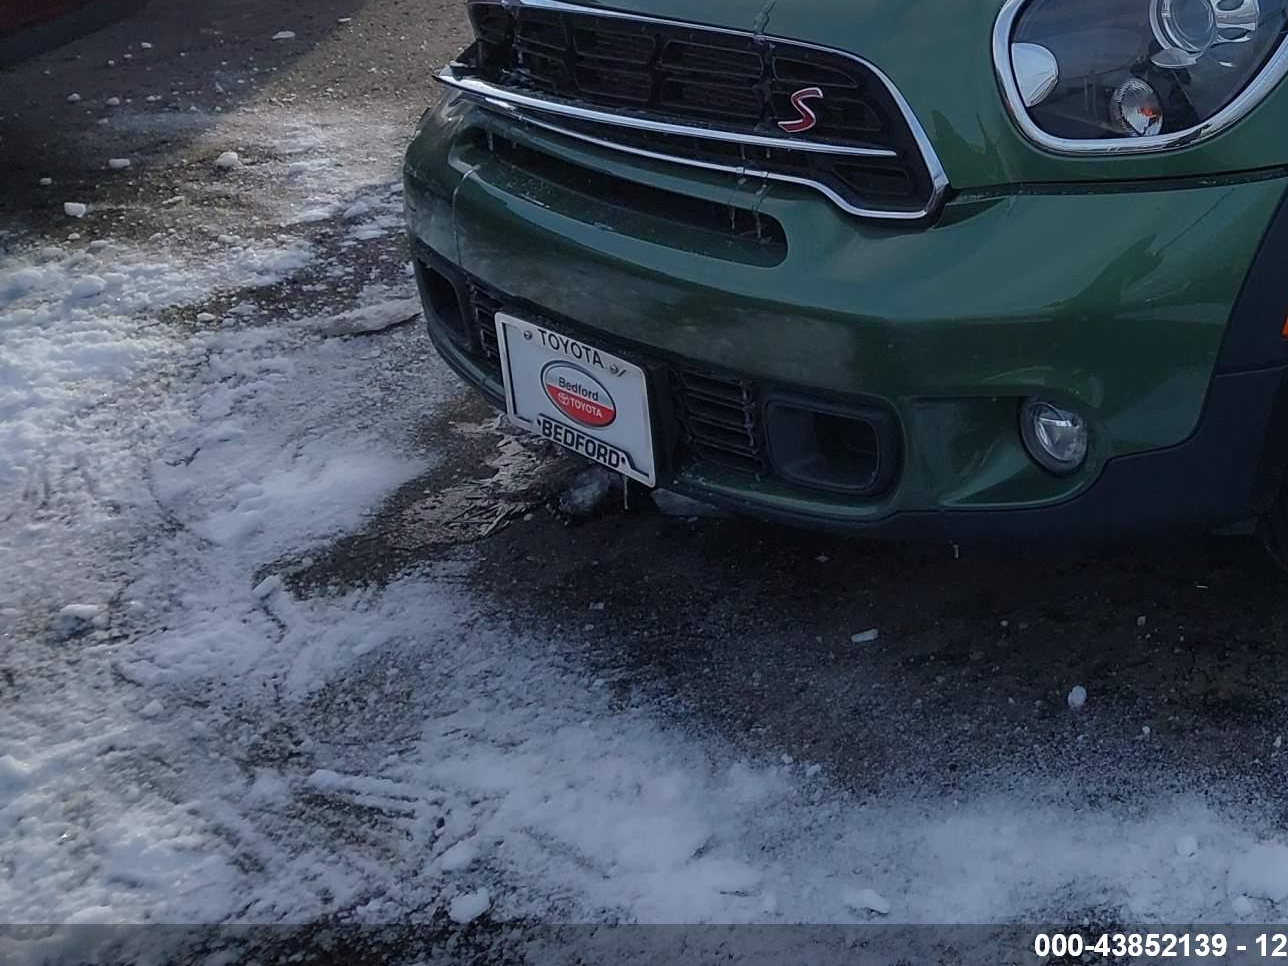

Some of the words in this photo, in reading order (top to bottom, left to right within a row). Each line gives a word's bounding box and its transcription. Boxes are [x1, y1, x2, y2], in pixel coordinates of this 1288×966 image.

[777, 87, 824, 133] S
[537, 328, 605, 370] TOYOTA
[558, 376, 600, 402] Bedford
[570, 397, 604, 419] TOYOTA
[541, 419, 620, 469] BEDFORD
